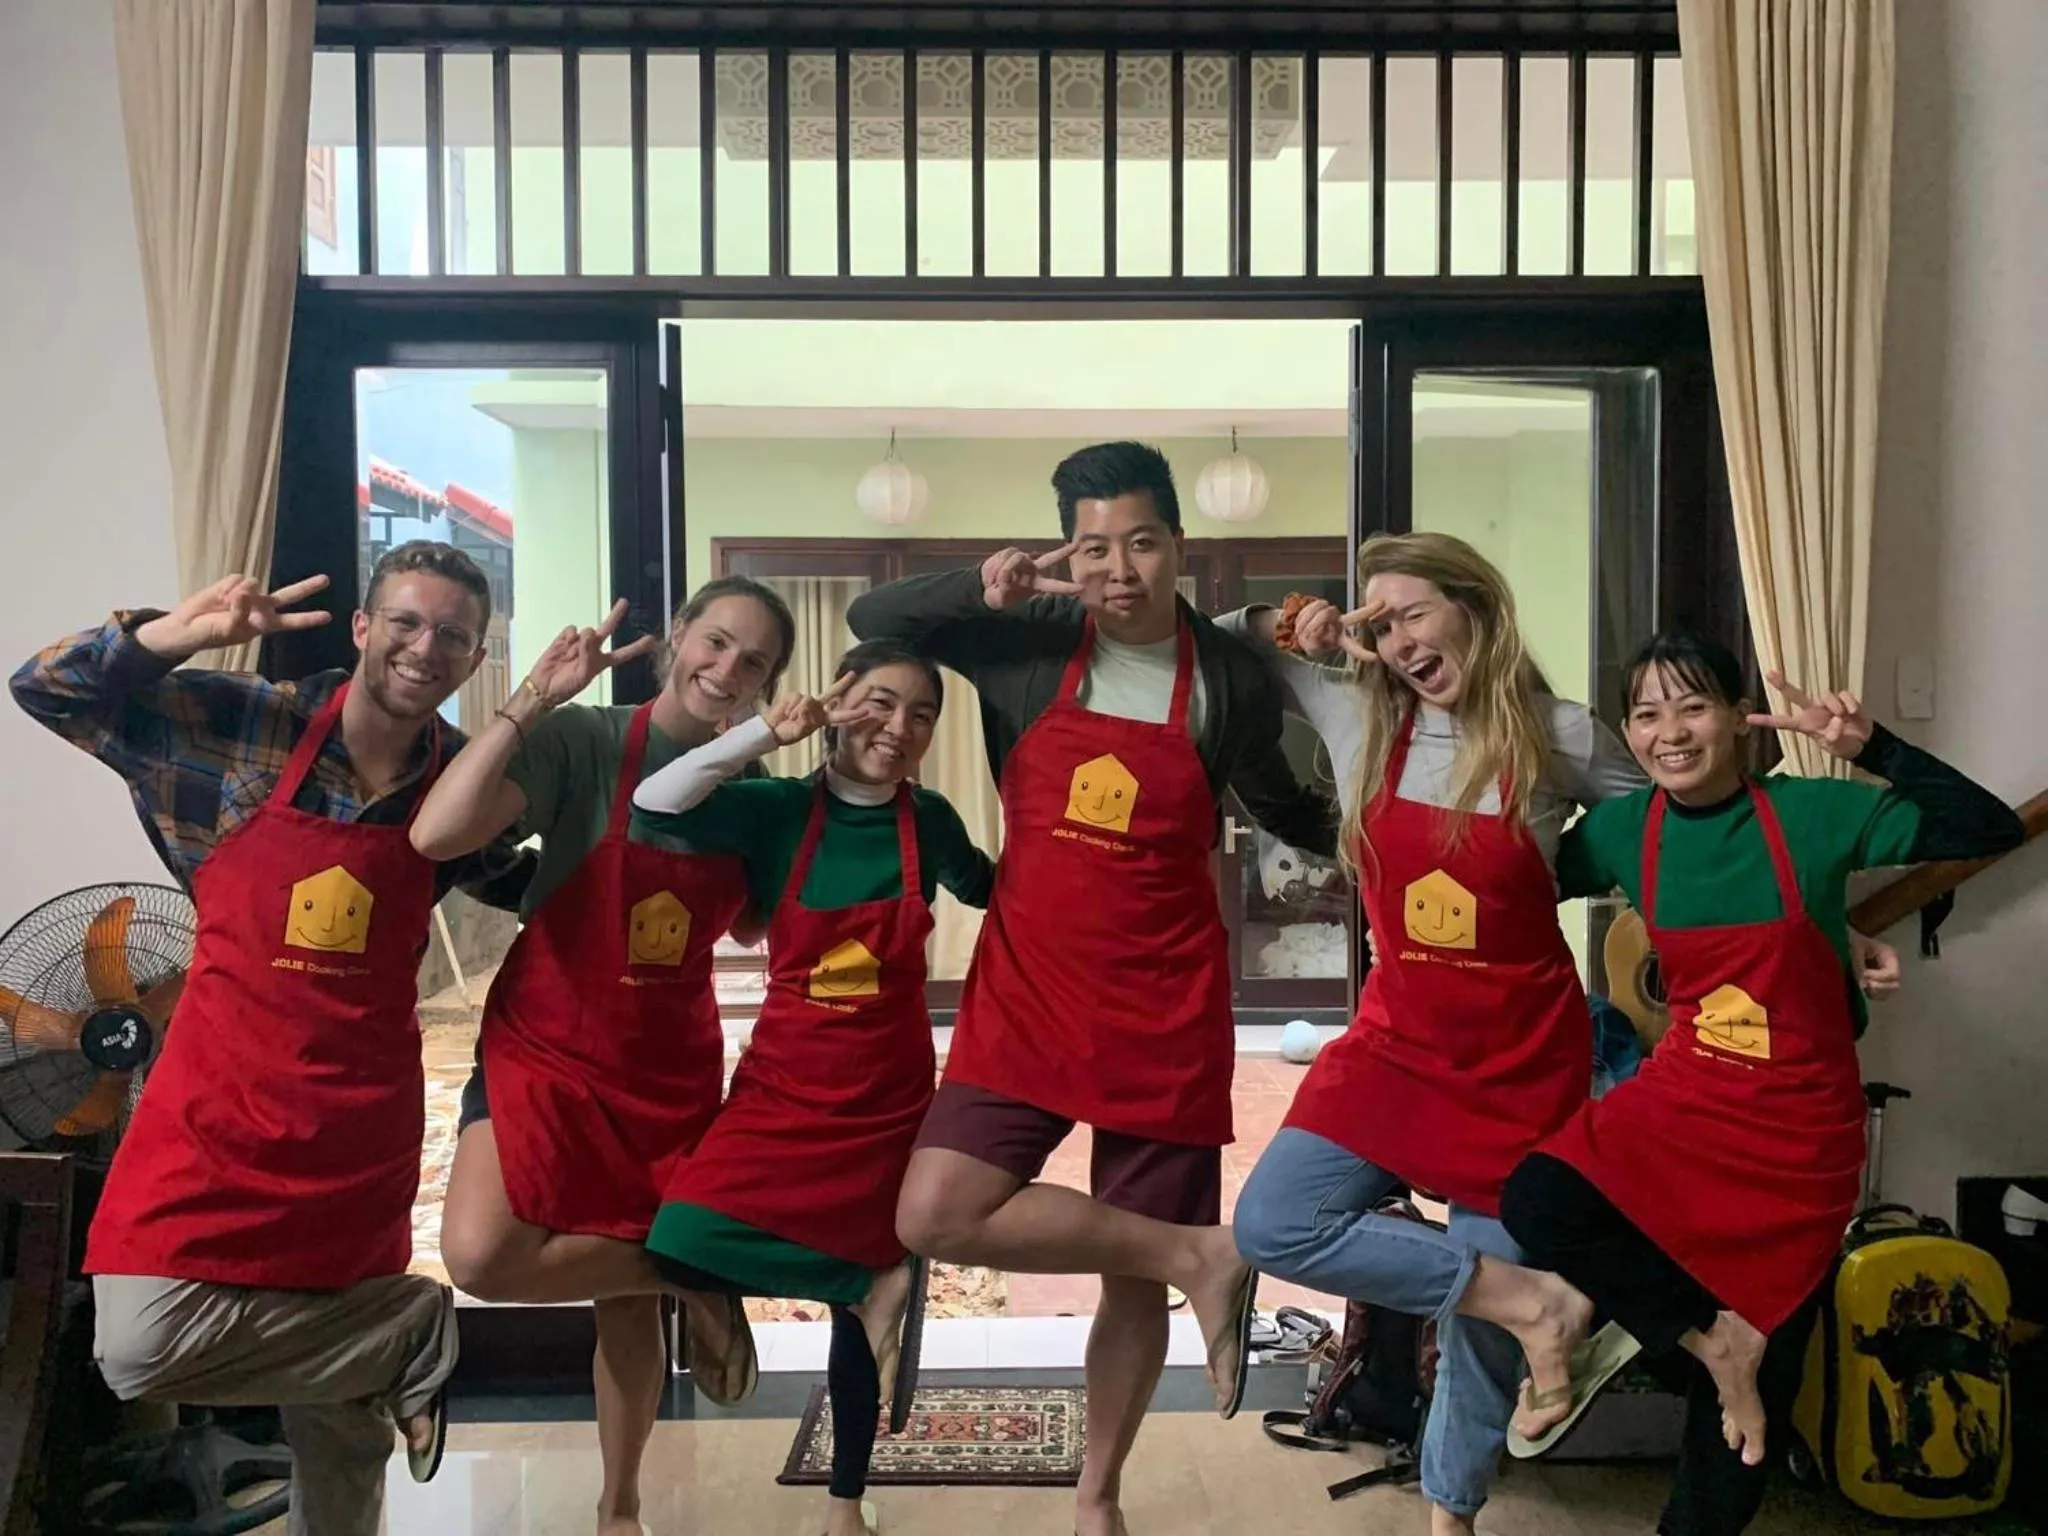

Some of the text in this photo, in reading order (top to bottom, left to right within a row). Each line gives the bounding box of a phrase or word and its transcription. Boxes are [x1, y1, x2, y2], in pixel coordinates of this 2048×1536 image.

[1052, 828, 1078, 839] JOLIE
[1399, 950, 1428, 962] JOLIE
[271, 958, 304, 971] JOLIE
